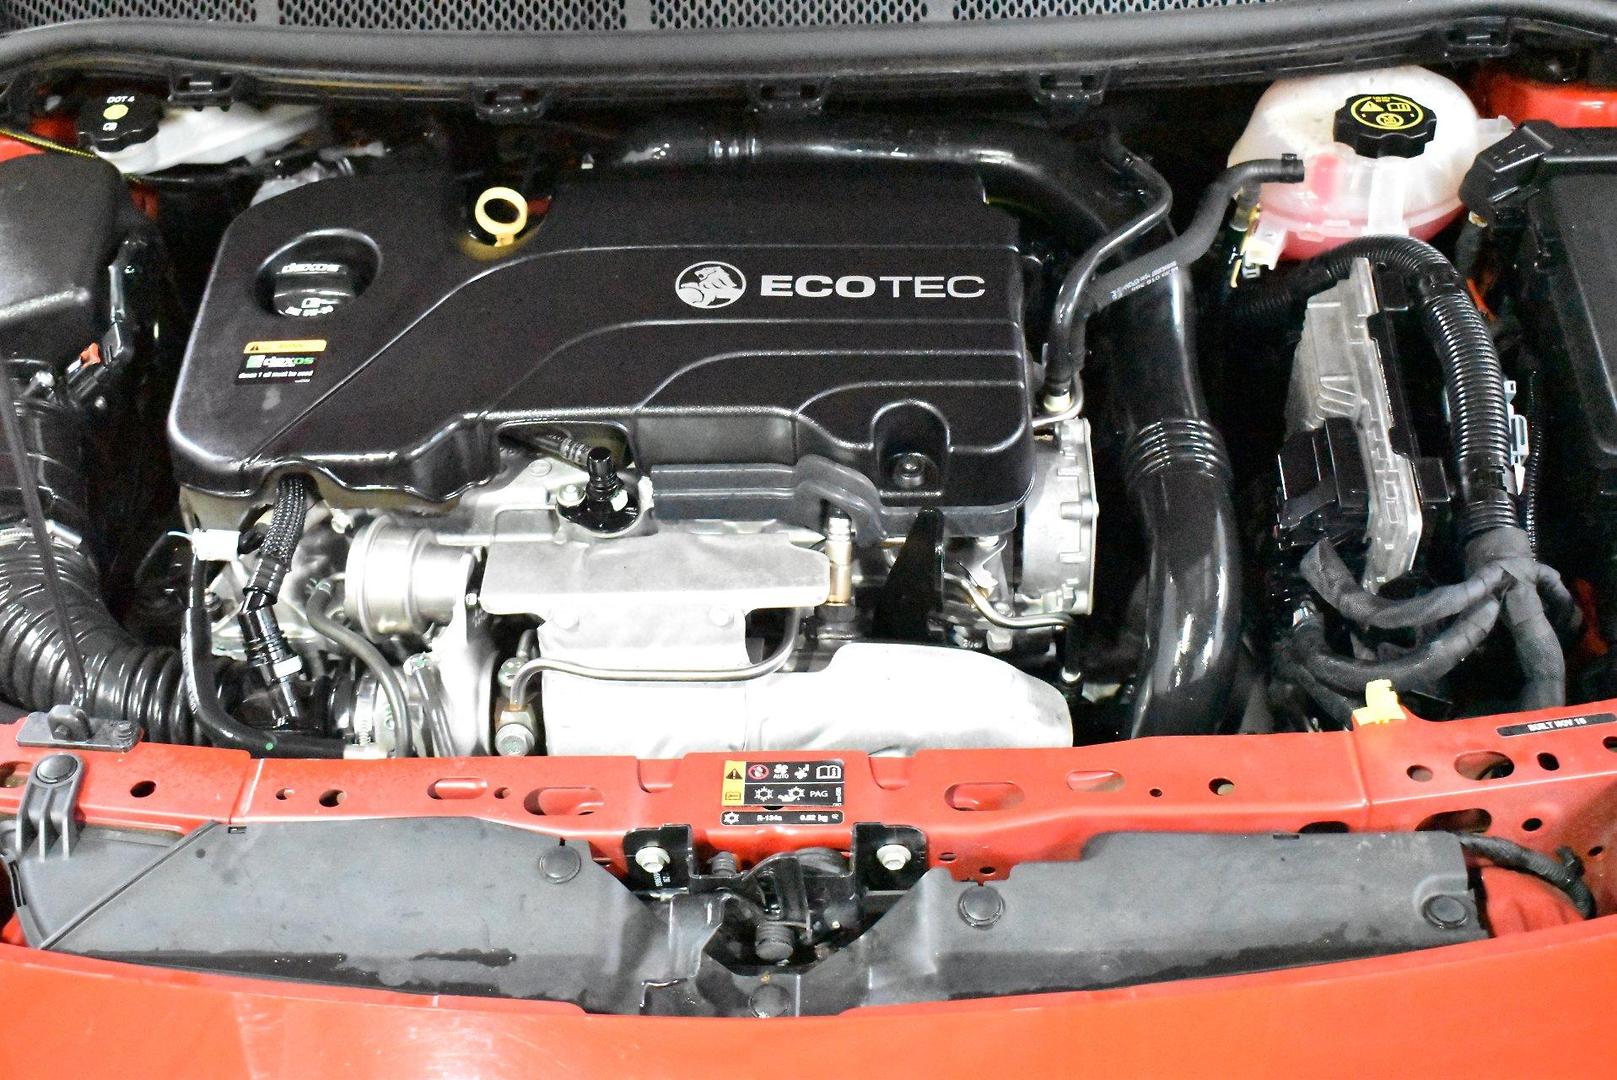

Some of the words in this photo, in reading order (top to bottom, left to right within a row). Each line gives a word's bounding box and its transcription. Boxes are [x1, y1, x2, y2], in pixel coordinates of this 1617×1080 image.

[107, 95, 128, 104] DOT
[760, 274, 986, 299] ECOTEC
[809, 790, 828, 798] PAG
